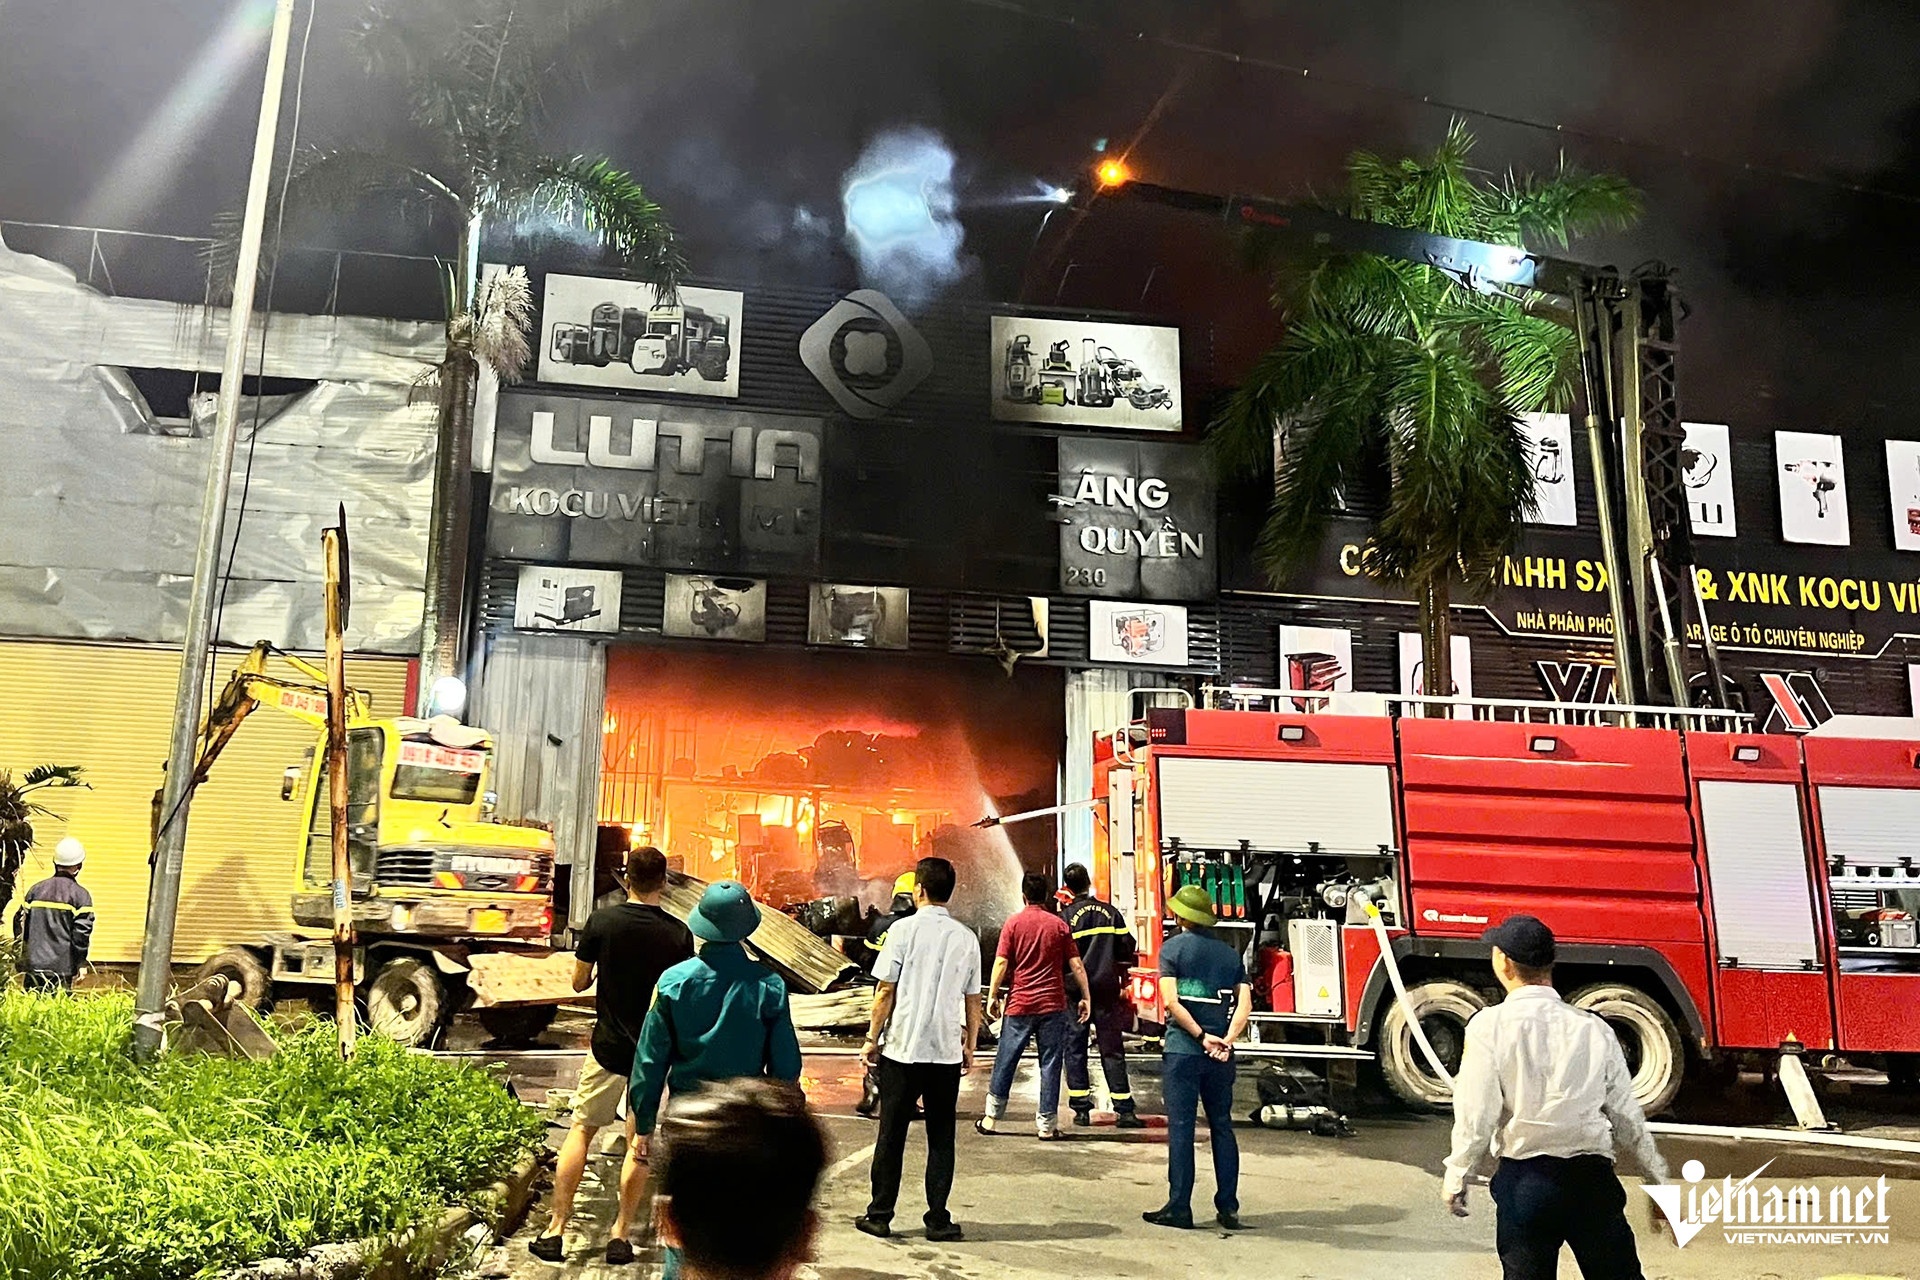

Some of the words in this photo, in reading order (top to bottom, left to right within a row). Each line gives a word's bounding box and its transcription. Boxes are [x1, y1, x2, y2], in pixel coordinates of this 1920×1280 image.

[508, 486, 609, 518] KOCU
[1080, 516, 1203, 558] QUYỀN
[1727, 570, 1790, 606] XNK
[1799, 575, 1880, 611] KOCU
[1888, 578, 1920, 614] VI
[1517, 608, 1546, 630] NHÀ
[1549, 610, 1585, 632] PHÂN
[1731, 621, 1741, 643] Ô
[1743, 622, 1761, 644] TÔ
[1764, 625, 1816, 649] CHUYÊN
[1819, 628, 1865, 654] NGHIỆP
